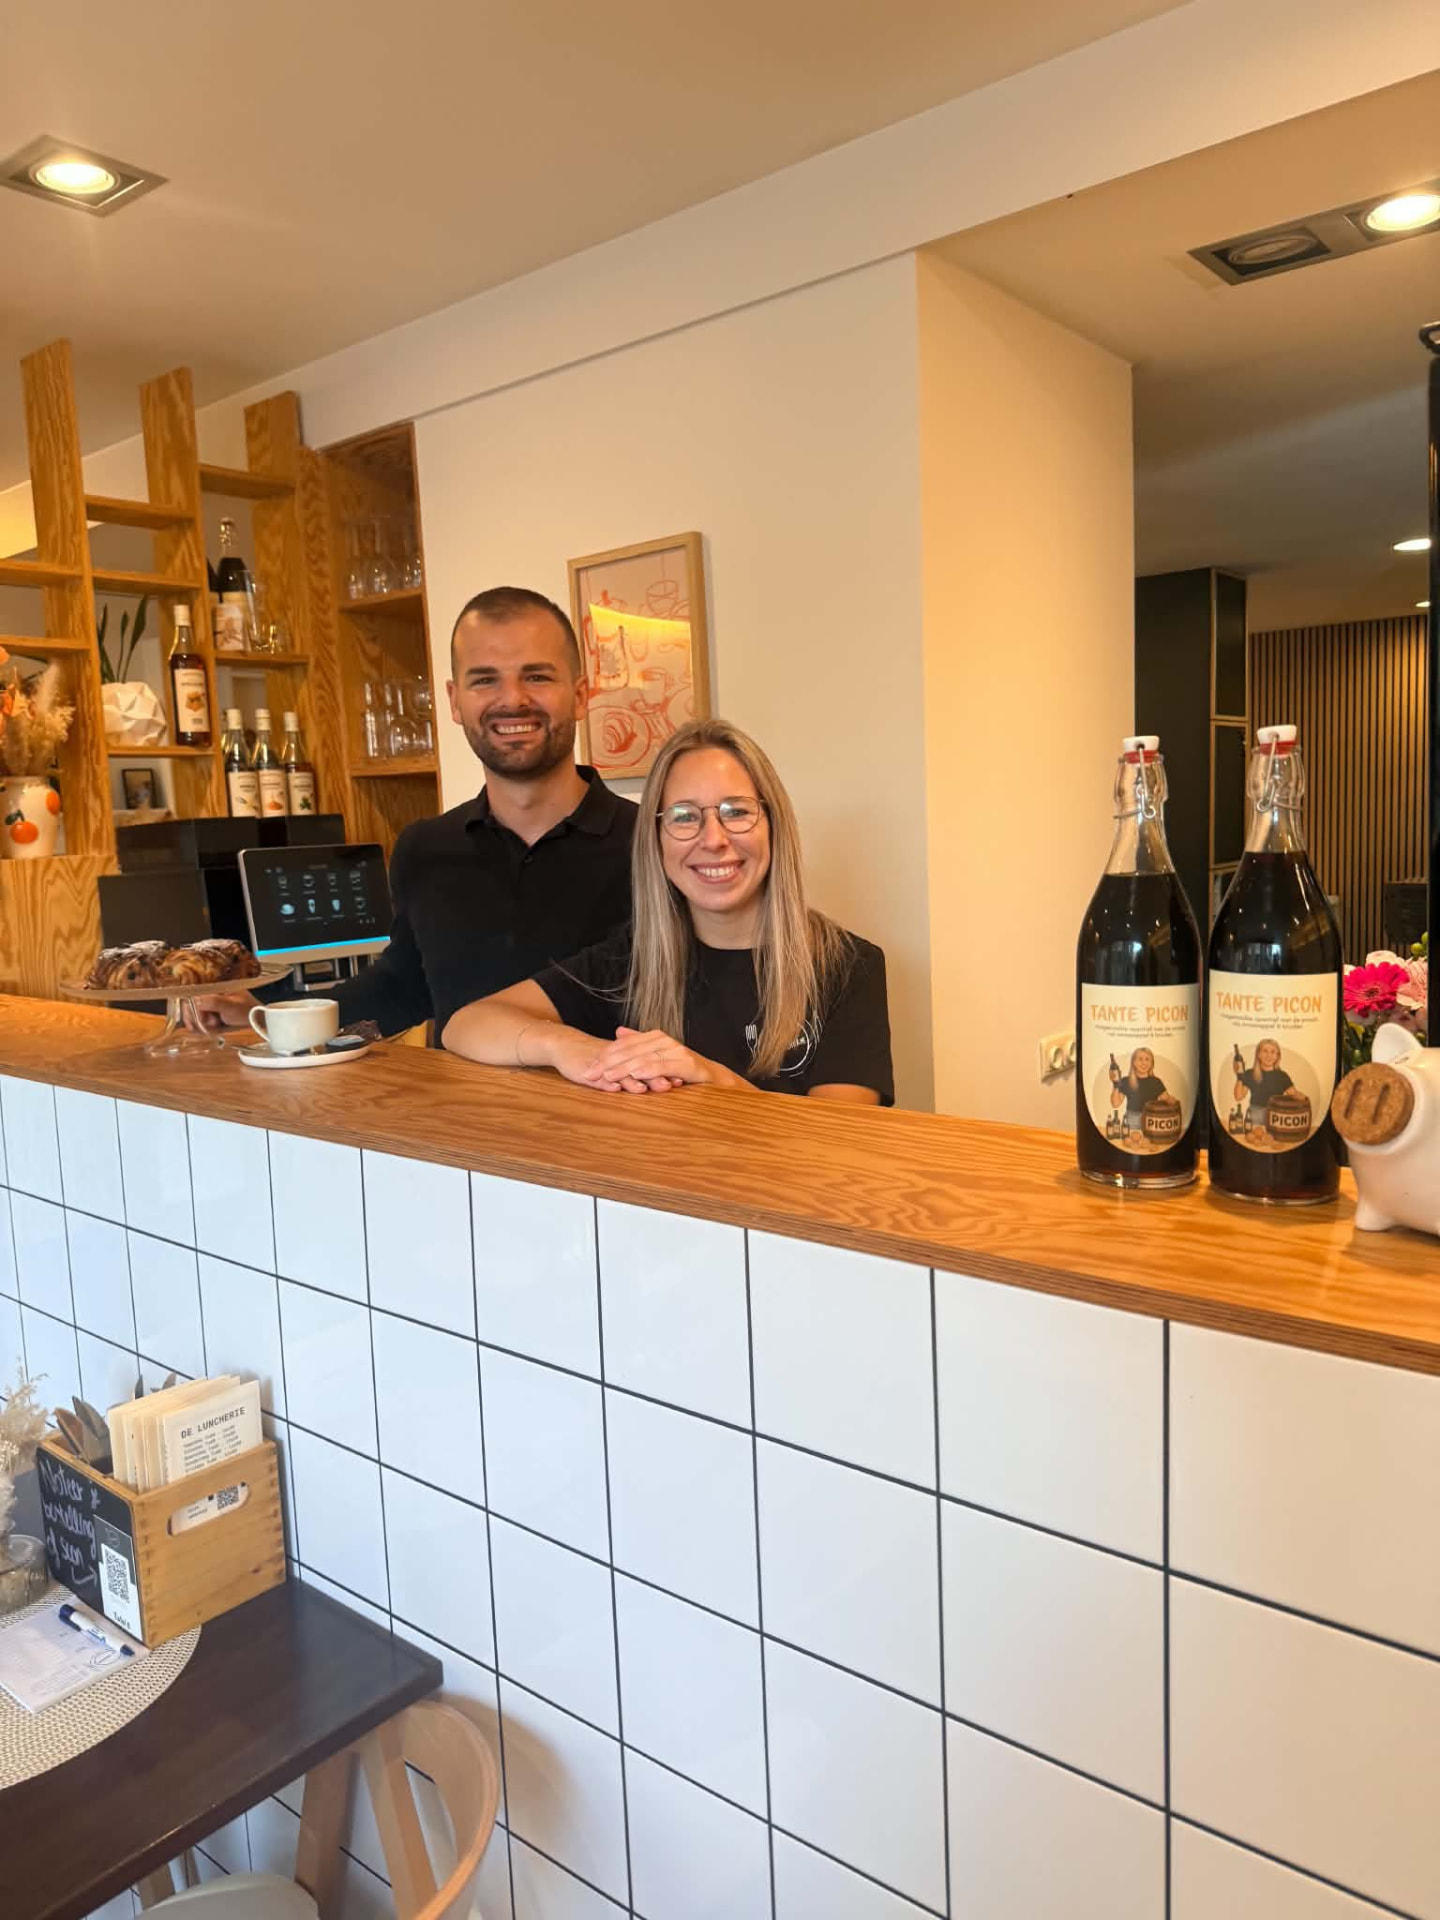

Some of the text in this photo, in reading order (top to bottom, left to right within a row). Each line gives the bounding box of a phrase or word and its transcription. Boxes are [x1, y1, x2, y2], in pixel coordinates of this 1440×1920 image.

[1215, 991, 1322, 1013] TANTE PICON
[1090, 1004, 1189, 1022] TANTE PICON
[1147, 1117, 1179, 1130] PICON
[1271, 1113, 1308, 1127] PICON
[181, 1406, 246, 1439] DE LUNCHERIE
